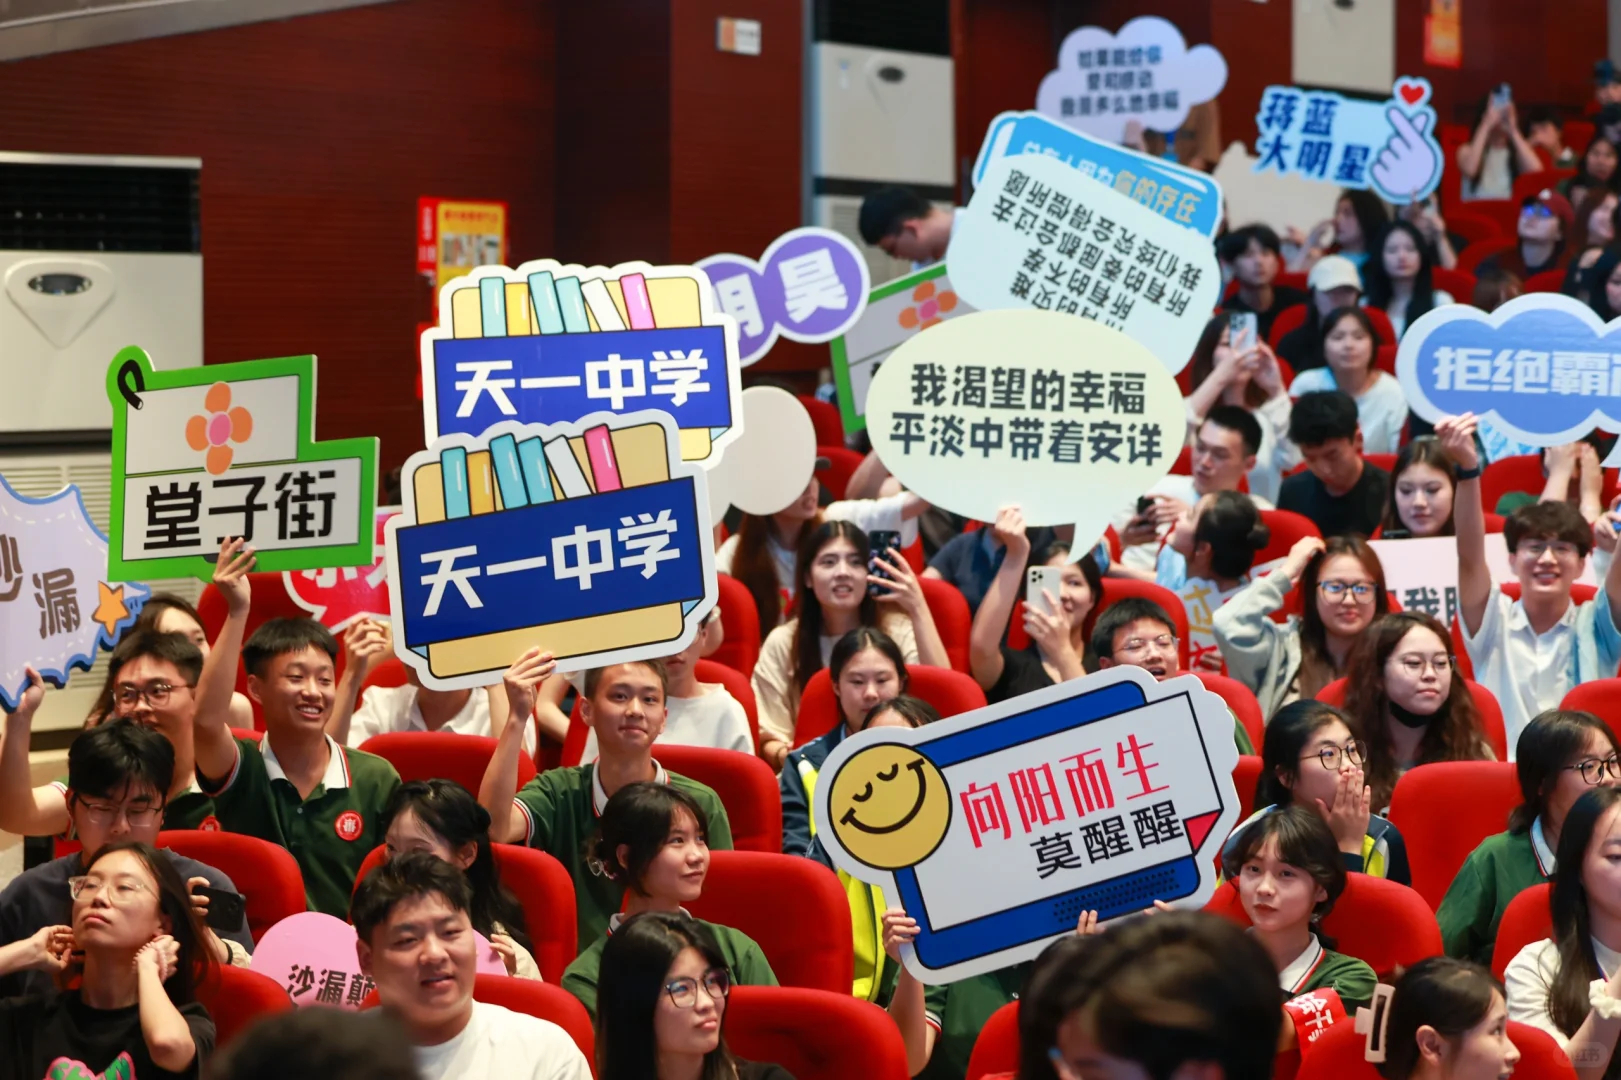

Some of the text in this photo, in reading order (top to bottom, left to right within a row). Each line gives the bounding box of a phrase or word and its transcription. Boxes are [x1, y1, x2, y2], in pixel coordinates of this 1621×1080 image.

[1257, 135, 1370, 183] 大明星
[991, 195, 1192, 318] 所有的委屈都会过去
[1002, 169, 1203, 291] 我们终究会得偿所愿
[1010, 271, 1123, 332] 的灾难
[455, 349, 710, 418] 天一中学
[911, 362, 1147, 415] 我渴望的幸福
[1432, 346, 1621, 397] 拒绝霸
[889, 411, 1163, 466] 平淡中带着安详
[143, 470, 336, 550] 堂子街
[420, 509, 681, 617] 天一中学
[959, 733, 1170, 849] 向阳而生
[1030, 800, 1184, 880] 莫醒醒
